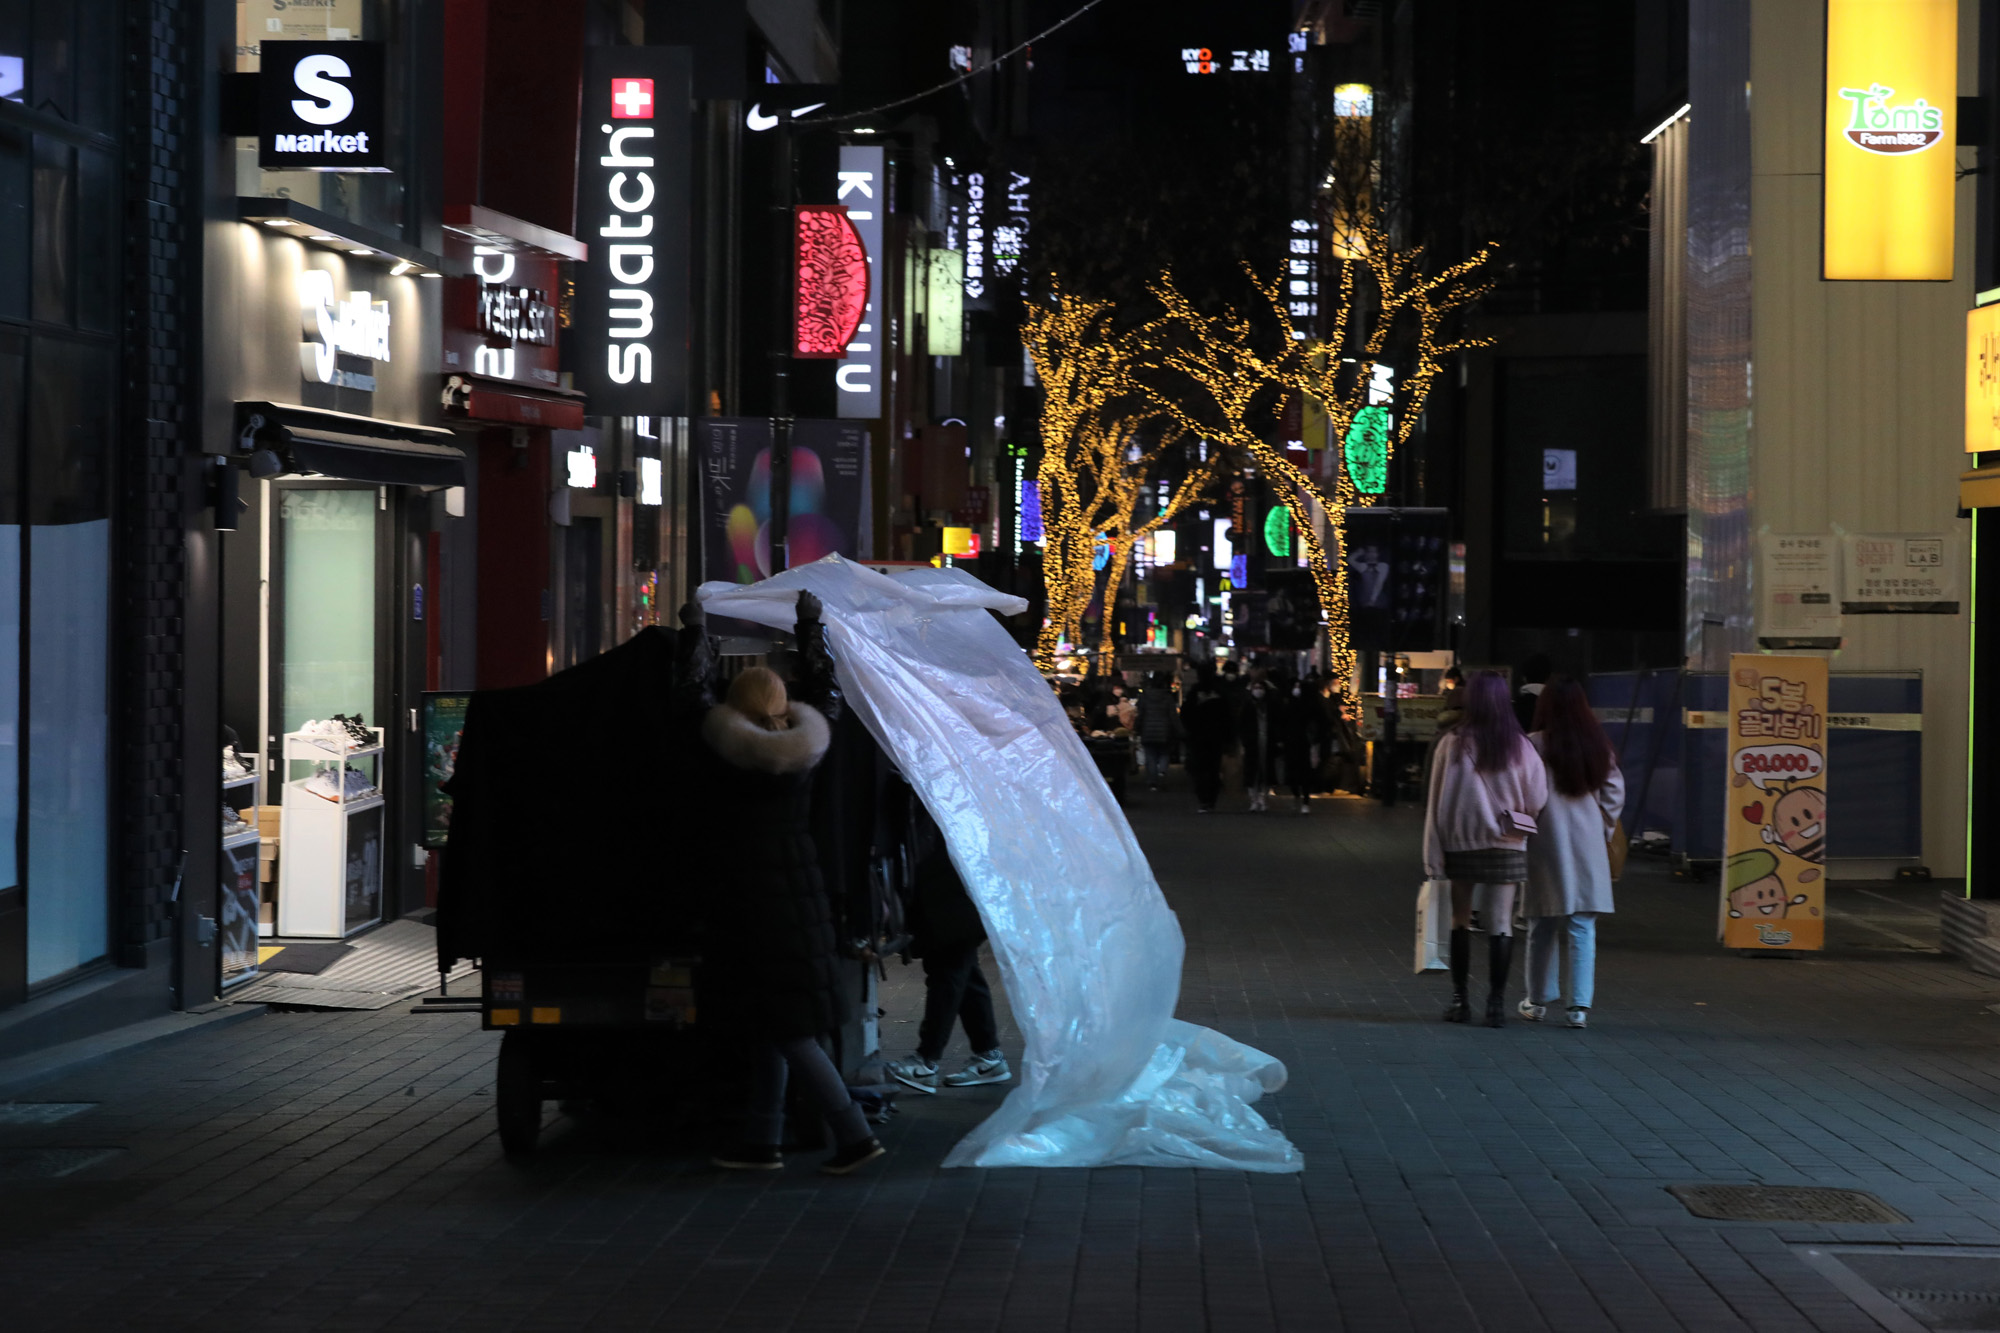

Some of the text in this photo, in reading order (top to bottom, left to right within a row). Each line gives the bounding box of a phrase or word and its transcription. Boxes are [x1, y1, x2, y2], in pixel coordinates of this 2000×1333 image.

[1230, 49, 1270, 71] 교원
[291, 53, 355, 126] S
[1841, 84, 1941, 131] Tom's
[599, 122, 656, 385] swatch
[1909, 554, 1939, 563] LAB
[1760, 676, 1806, 713] 5봉
[1738, 709, 1821, 739] 골라담기
